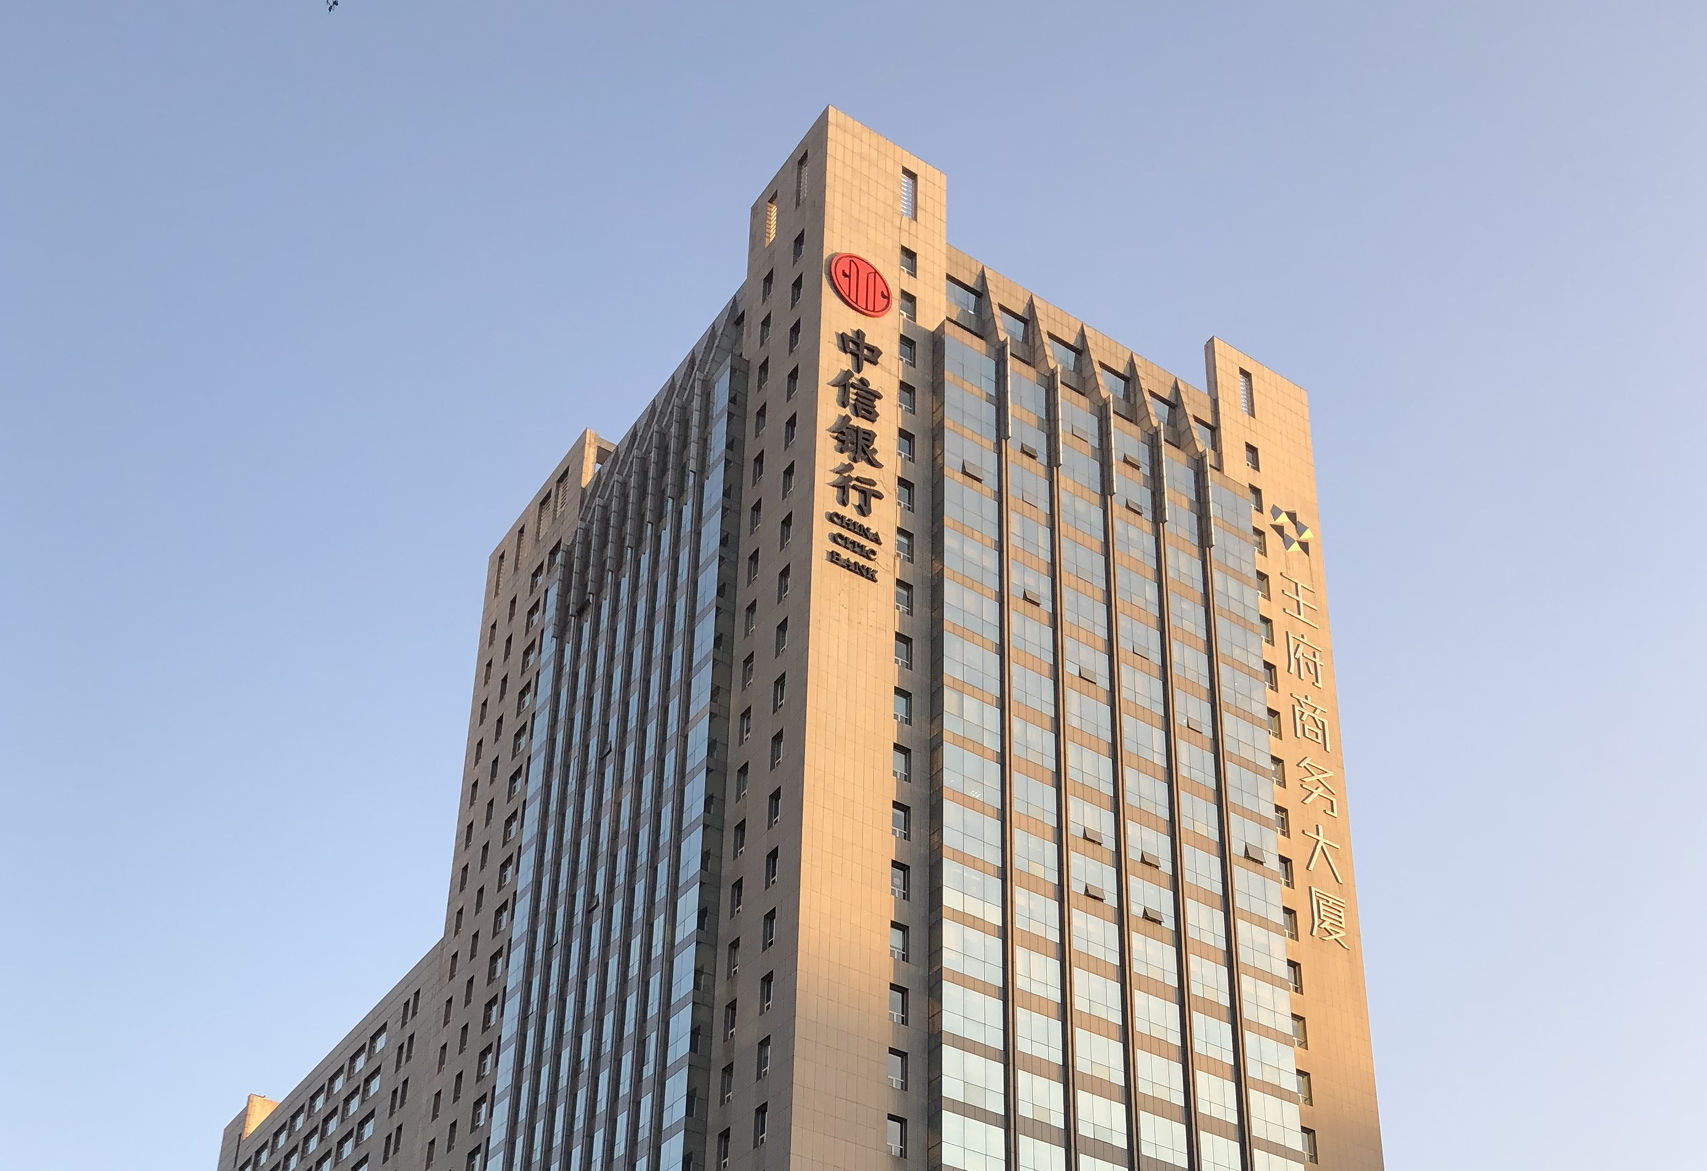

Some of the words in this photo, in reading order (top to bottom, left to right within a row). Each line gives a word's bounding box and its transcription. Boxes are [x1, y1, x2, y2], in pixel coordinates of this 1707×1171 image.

[825, 512, 882, 545] CHINA
[828, 532, 878, 561] CITIC
[826, 550, 878, 583] BANK
[1280, 571, 1351, 950] 王府商务大厦
